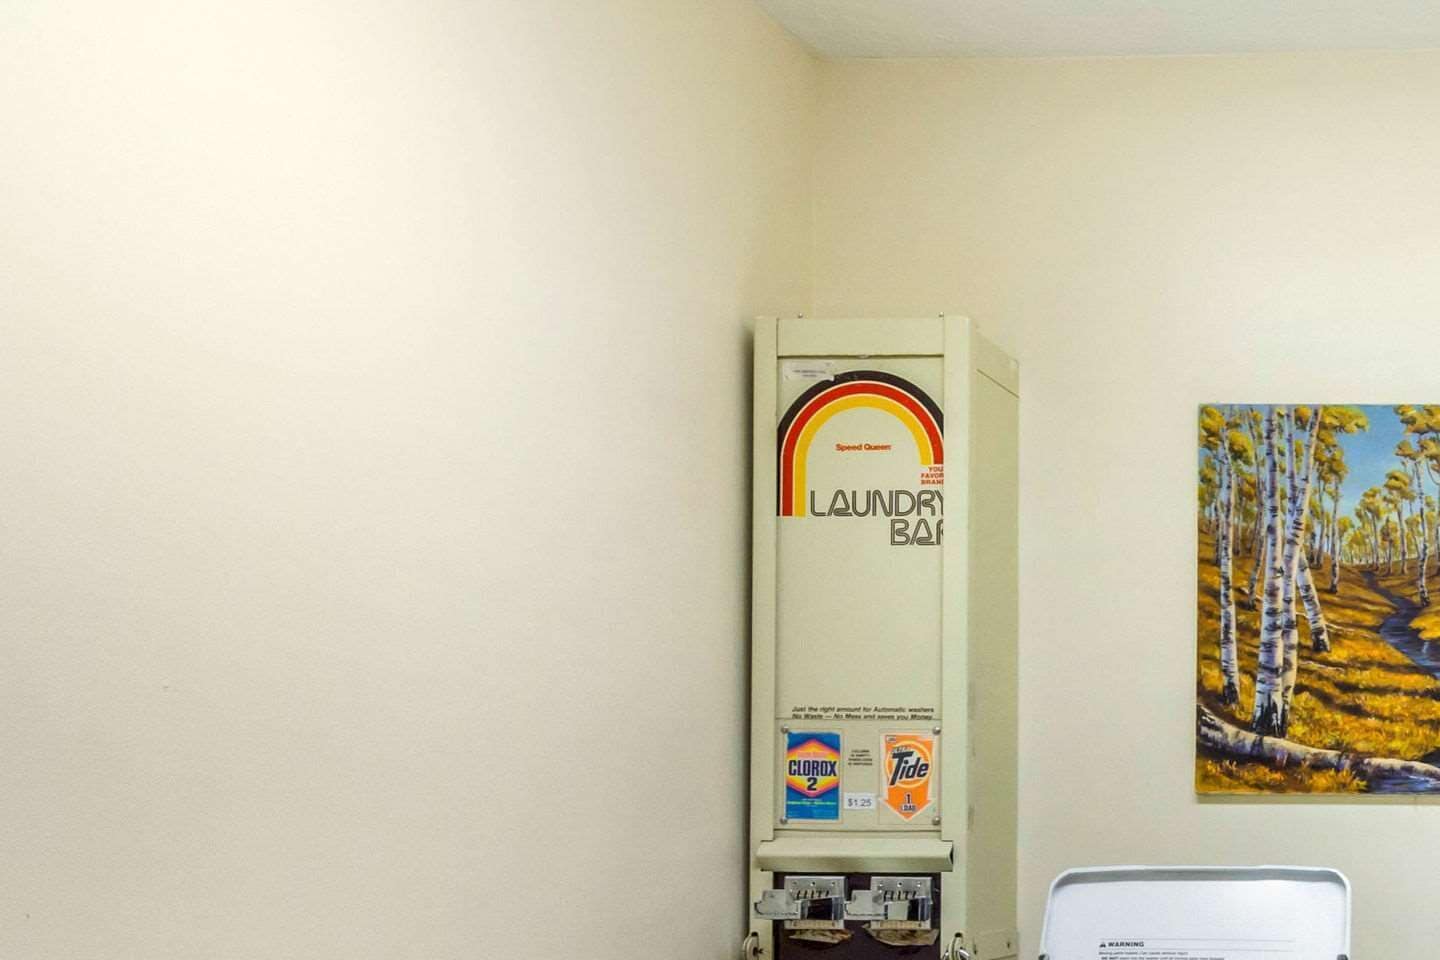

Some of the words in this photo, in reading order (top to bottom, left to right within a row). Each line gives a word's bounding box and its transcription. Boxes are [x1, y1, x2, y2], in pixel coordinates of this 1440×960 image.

[835, 443, 863, 452] Speed
[788, 759, 837, 777] CLOROX
[889, 751, 929, 786] Tide
[806, 777, 818, 791] 2
[847, 798, 872, 808] $1.25
[906, 793, 911, 804] 1
